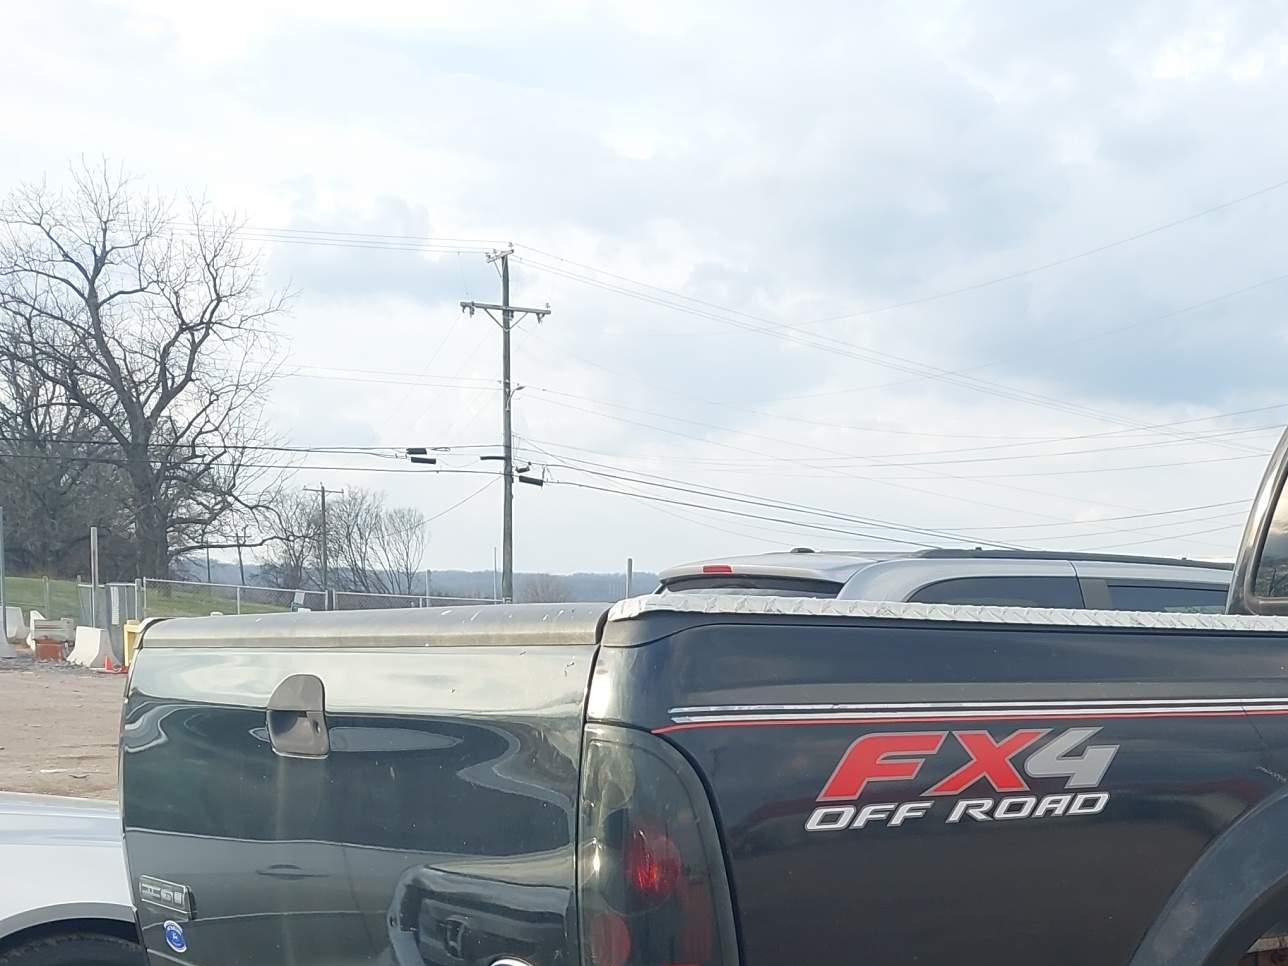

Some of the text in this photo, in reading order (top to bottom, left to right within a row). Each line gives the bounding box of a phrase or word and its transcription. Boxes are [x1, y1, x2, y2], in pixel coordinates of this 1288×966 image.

[816, 727, 1120, 802] FX4
[804, 791, 1111, 832] OFF ROAD
